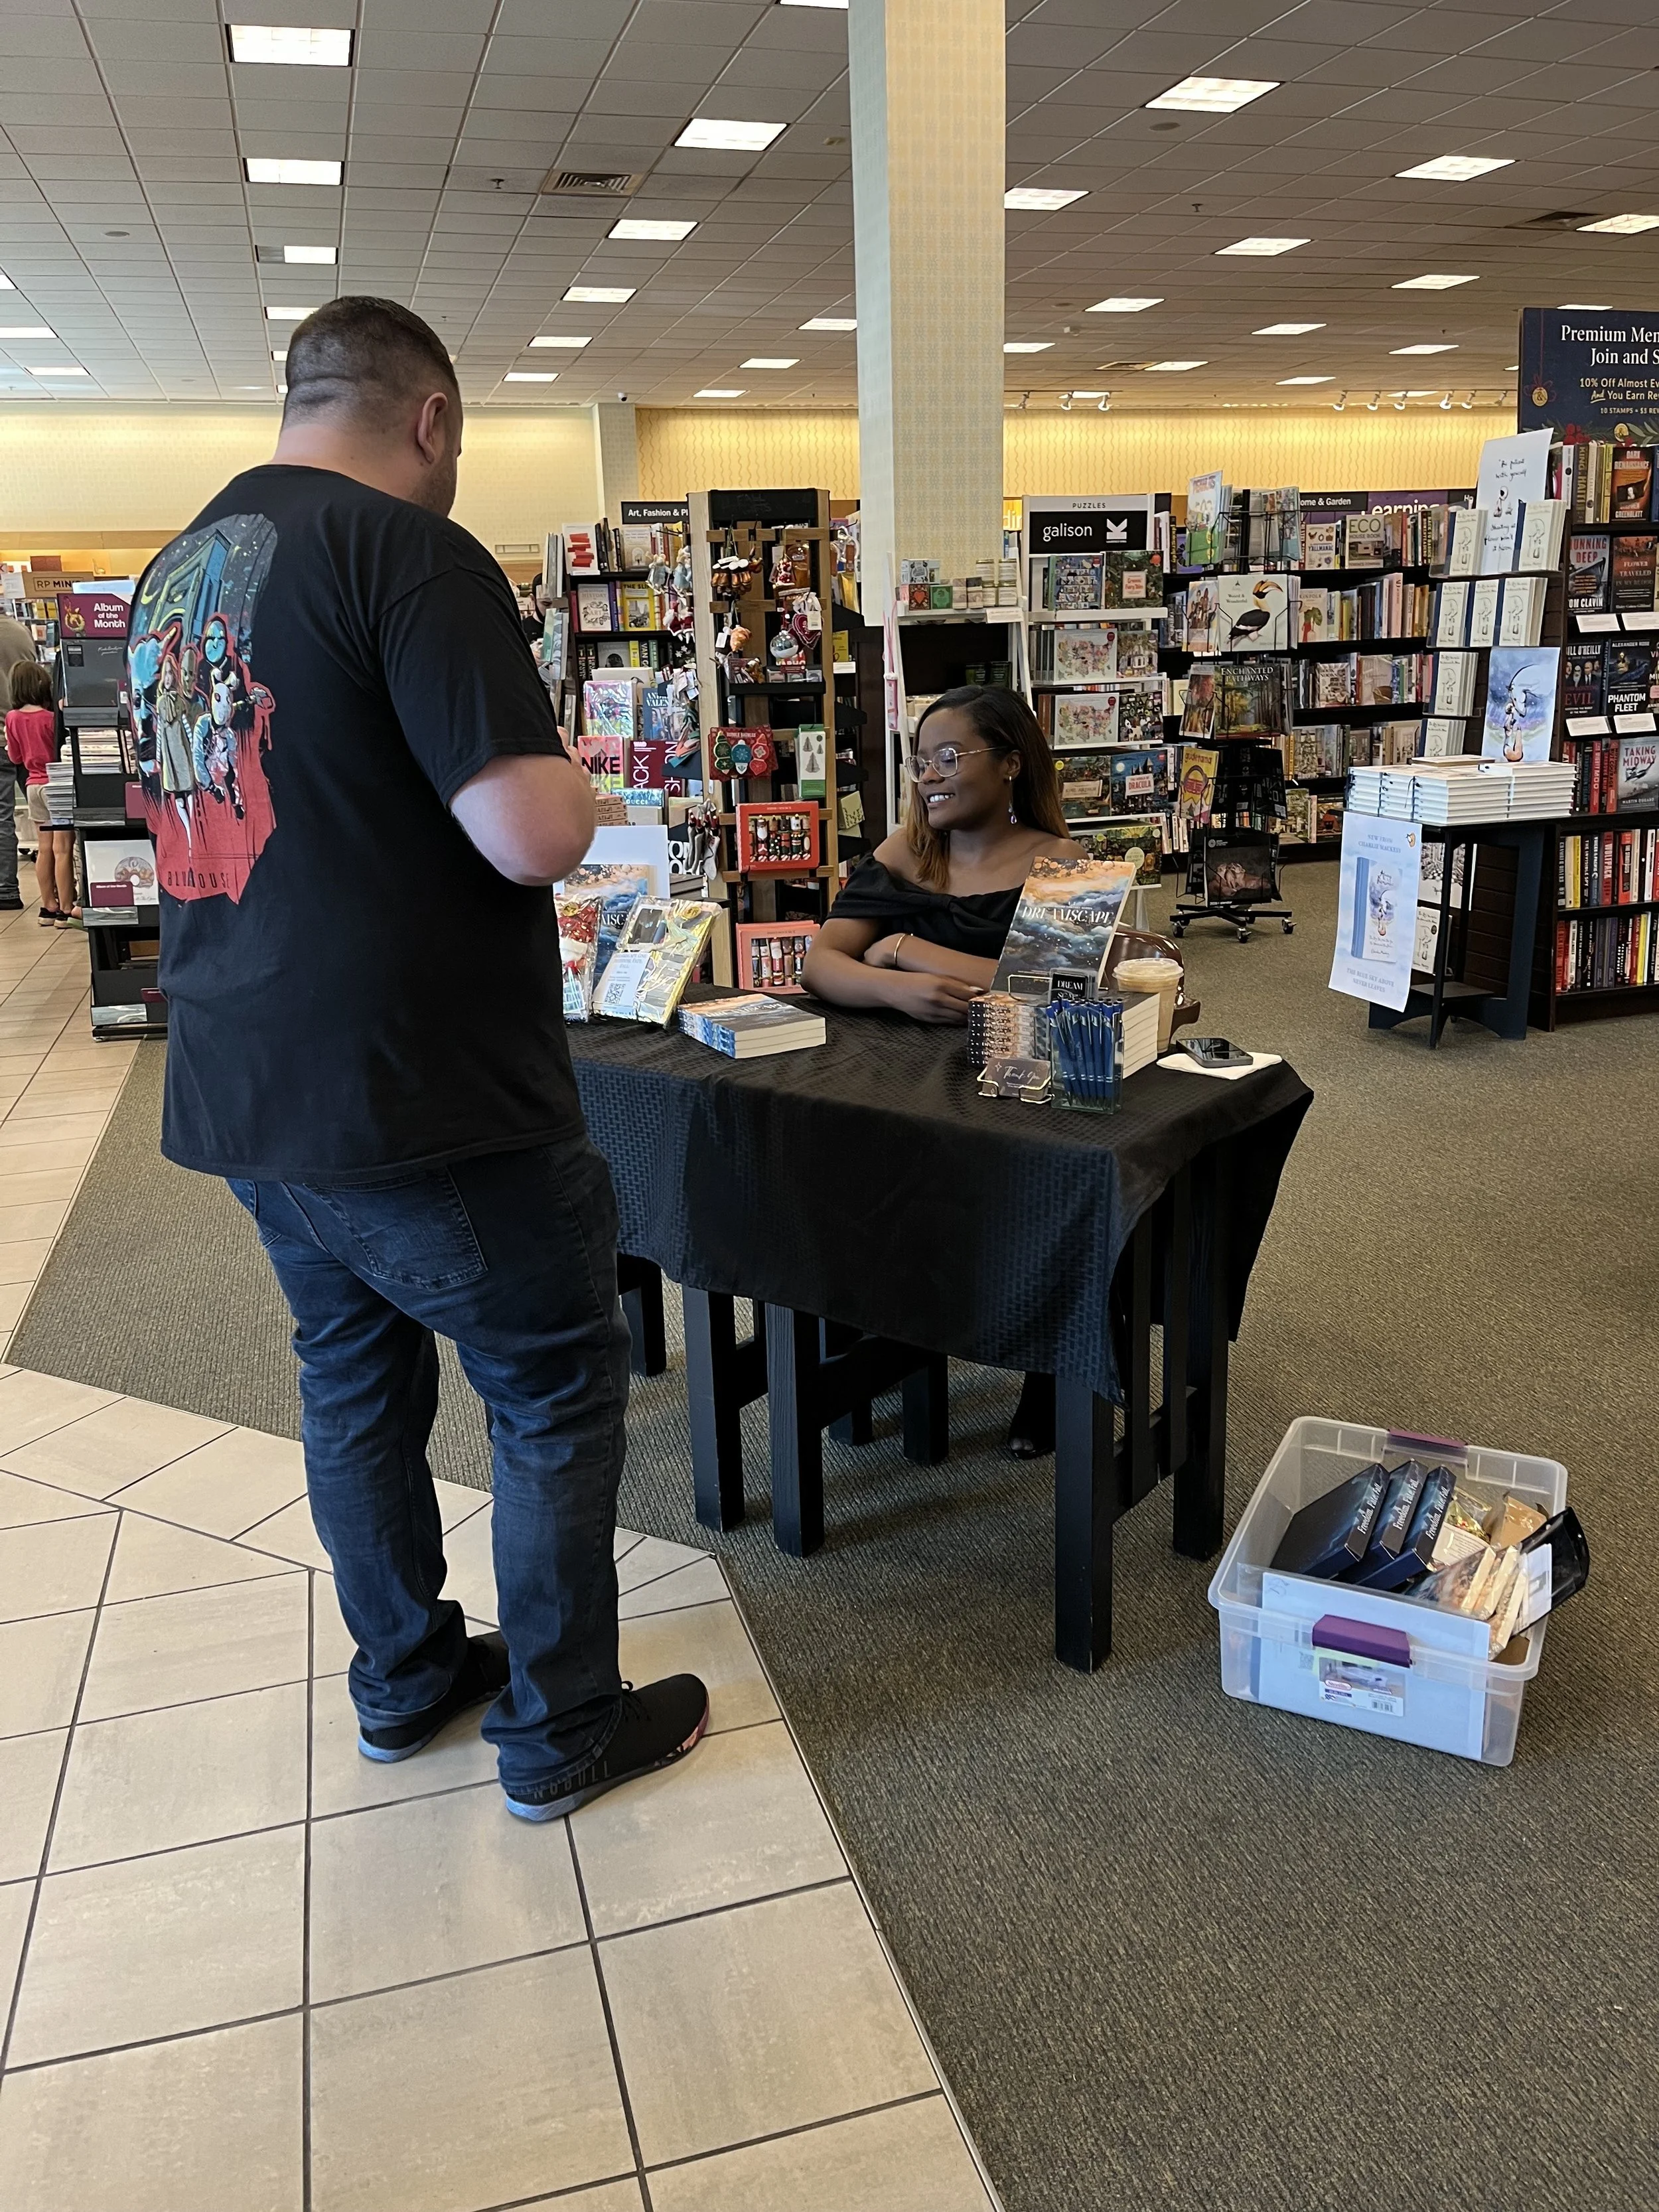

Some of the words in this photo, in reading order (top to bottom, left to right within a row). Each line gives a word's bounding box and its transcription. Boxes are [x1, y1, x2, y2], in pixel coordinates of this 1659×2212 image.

[1561, 325, 1626, 342] Premium
[1591, 348, 1619, 366] Join
[1623, 348, 1648, 364] and
[1579, 378, 1599, 388] 10%
[1601, 378, 1615, 388] Off
[1617, 378, 1648, 388] Almost
[1591, 390, 1606, 402] And
[1607, 390, 1623, 400] You
[1626, 391, 1645, 400] Earn
[1299, 498, 1317, 506] ome
[1317, 497, 1325, 506] &
[1326, 497, 1351, 506] Garden
[628, 509, 642, 518] Art,
[1348, 518, 1382, 534] ECO
[1043, 523, 1092, 542] galison
[1576, 552, 1599, 563] DEEP
[94, 603, 124, 612] Album
[1580, 597, 1603, 608] CLAVIN
[94, 619, 126, 628] Month
[1221, 666, 1273, 676] ENCHANTED
[1226, 674, 1269, 682] PATHWAYS
[1565, 692, 1595, 705] EVIL
[1608, 693, 1646, 703] PHANTOM
[1615, 703, 1638, 713] FLEET
[1624, 745, 1656, 757] TAKING
[582, 756, 620, 774] NIKE
[1622, 755, 1657, 767] MIDWAY
[1128, 780, 1152, 790] DRACULA
[1358, 840, 1379, 850] CHARLIE
[1380, 843, 1402, 854] MACKESY
[1603, 843, 1613, 879] WOLFPACK
[1022, 906, 1114, 924] DREAMSCAPE
[1346, 967, 1356, 976] THE
[1356, 969, 1368, 979] BLUE
[1369, 972, 1378, 982] SKY
[1378, 976, 1394, 988] ABOVE
[1057, 980, 1084, 991] DREAM
[1352, 977, 1368, 988] NEVER
[1368, 981, 1386, 994] LEAVES
